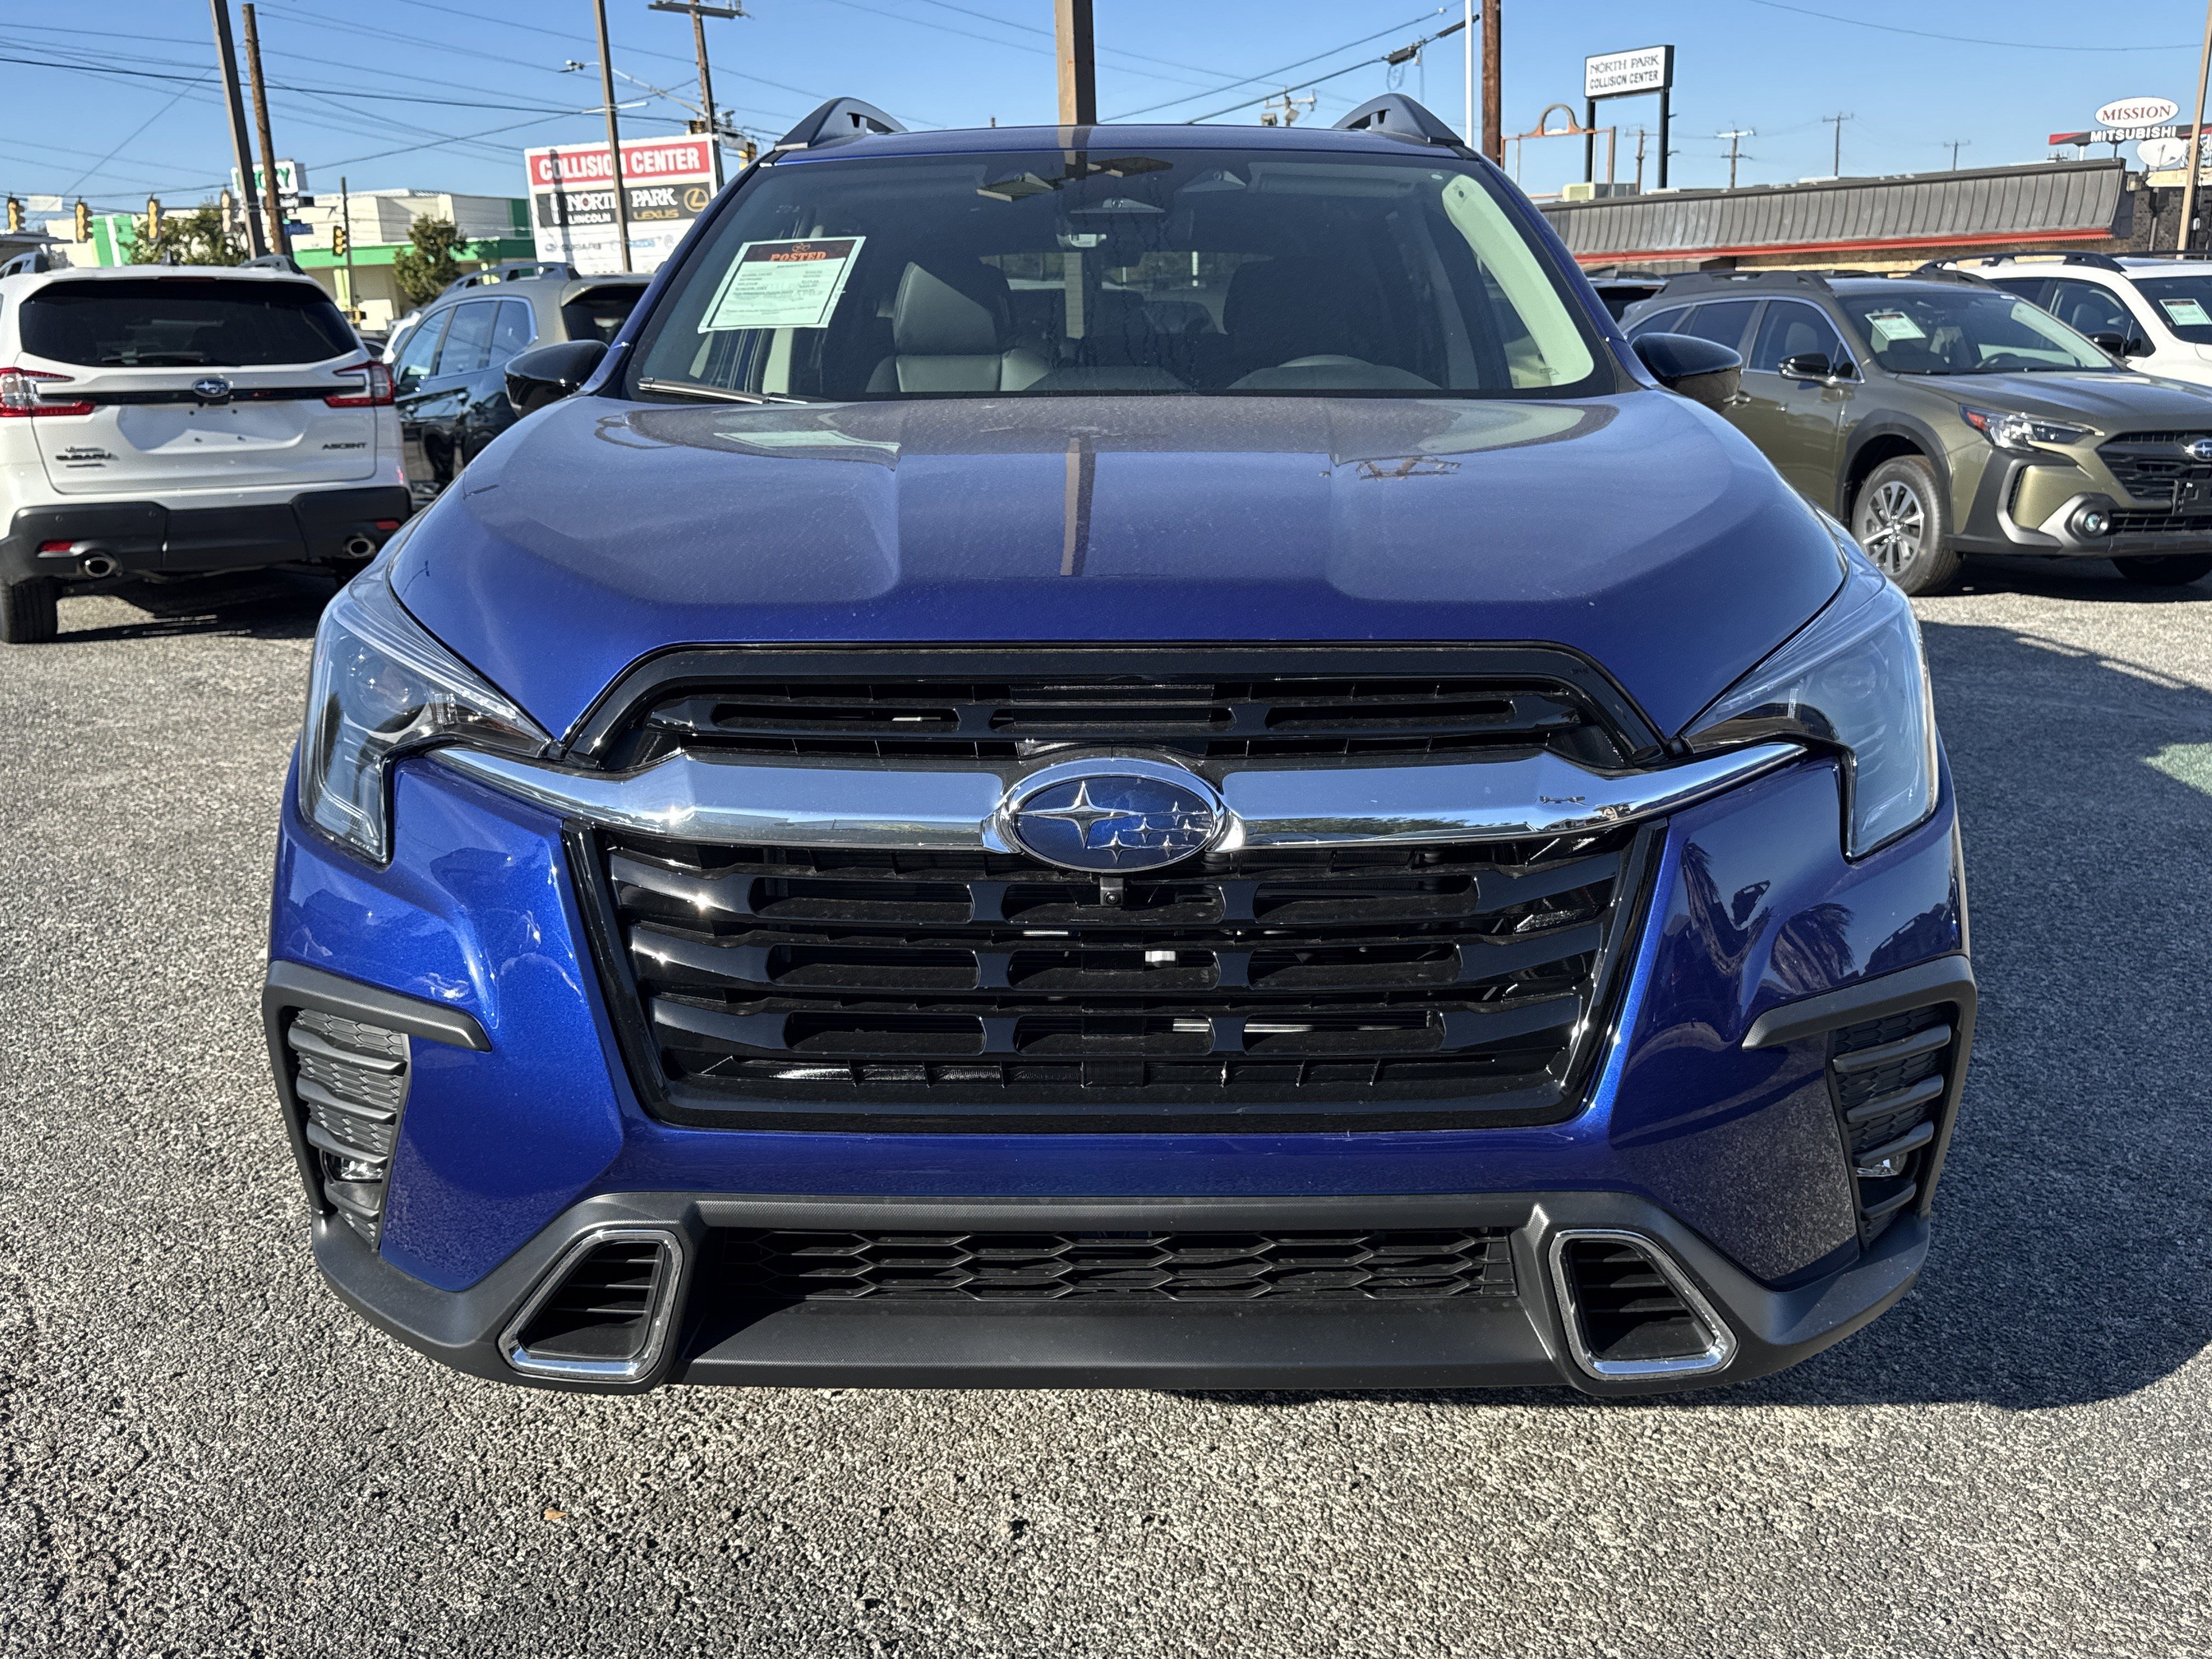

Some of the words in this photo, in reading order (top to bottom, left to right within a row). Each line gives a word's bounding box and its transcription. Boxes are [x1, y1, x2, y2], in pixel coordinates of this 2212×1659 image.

[1590, 59, 1627, 75] NORTH
[1630, 54, 1660, 69] PARK
[1590, 75, 1627, 89] COLLISION
[1629, 70, 1658, 84] CENTER
[2102, 105, 2171, 121] MISSION
[2090, 126, 2176, 143] MITSUBISHI
[630, 147, 699, 173] CENTER
[630, 188, 678, 207] PARK
[568, 212, 611, 224] LINCOLN
[633, 208, 679, 221] LEXUS
[770, 251, 826, 261] POSTED
